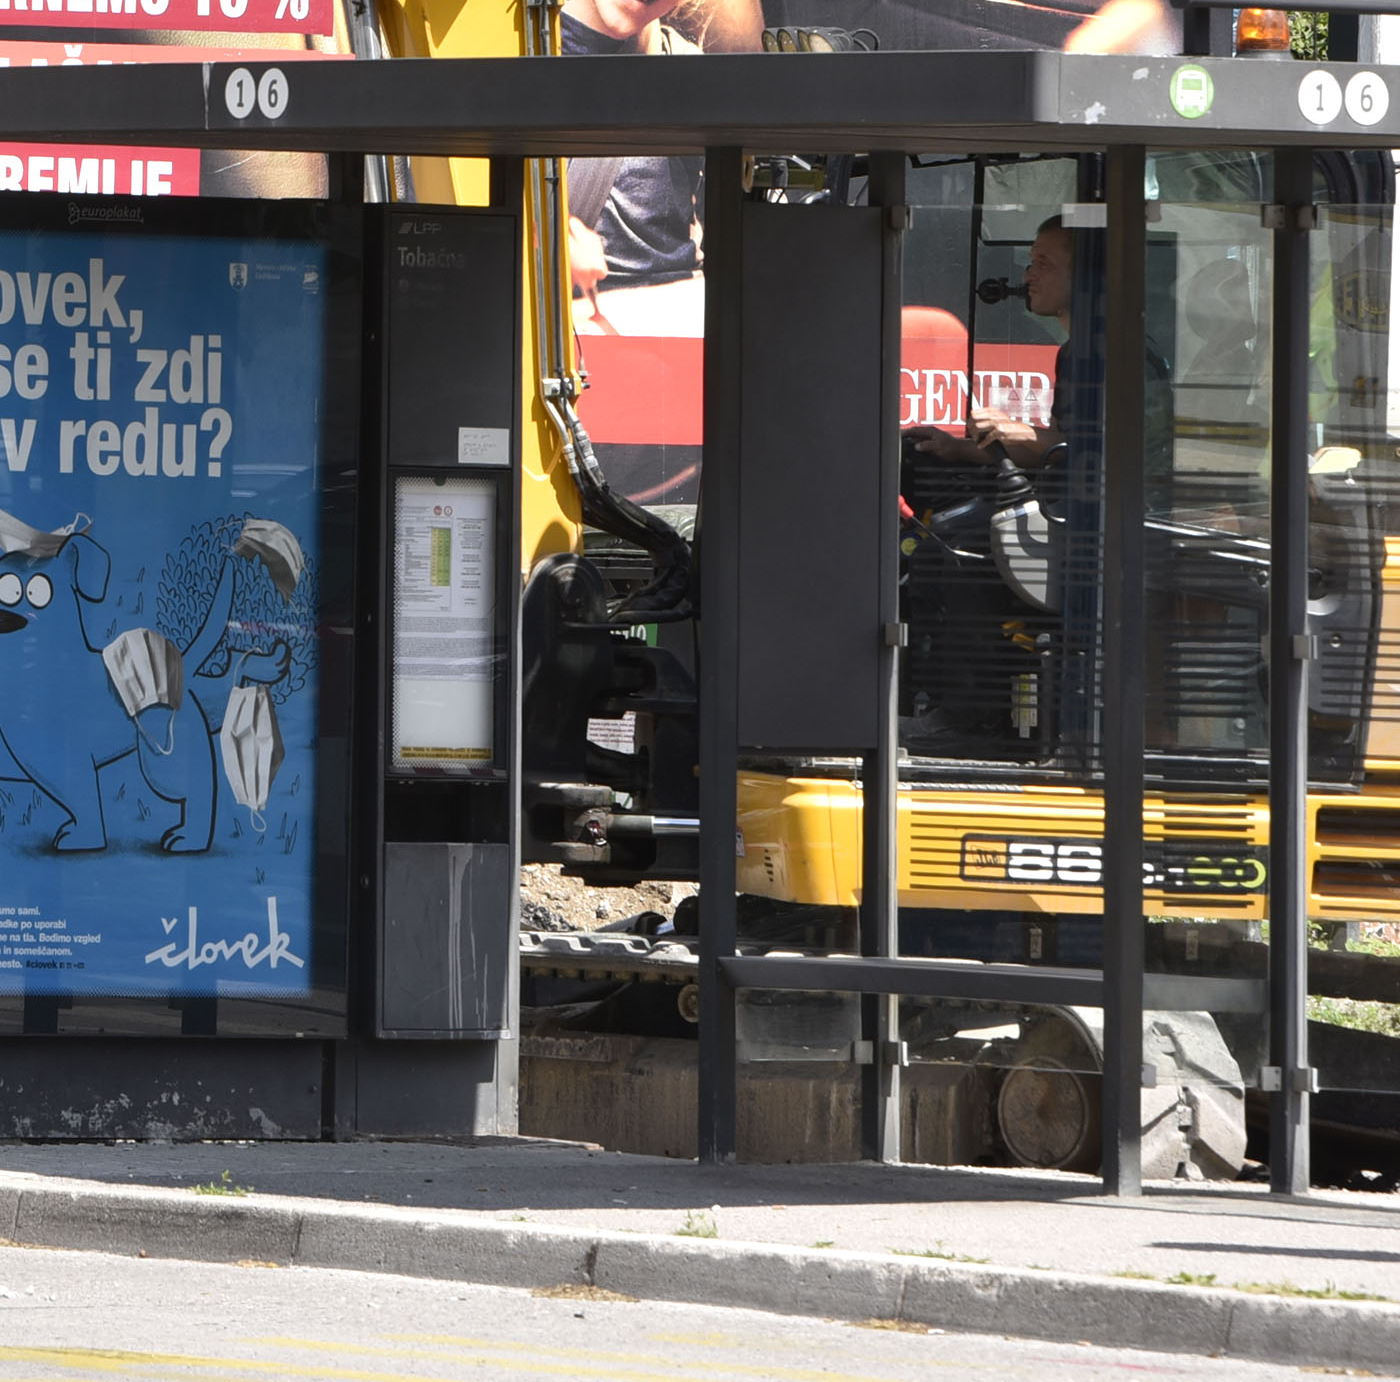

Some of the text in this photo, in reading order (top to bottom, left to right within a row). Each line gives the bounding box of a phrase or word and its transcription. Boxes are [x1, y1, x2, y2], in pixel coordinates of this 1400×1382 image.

[235, 78, 279, 109] 1 6
[1316, 83, 1373, 112] 1 6
[81, 205, 142, 220] europlakat
[69, 331, 112, 401] ti
[134, 334, 222, 404] zdi
[0, 418, 37, 472] v
[59, 406, 233, 478] redu?
[18, 905, 41, 916] sami.
[20, 921, 33, 930] po
[34, 919, 67, 931] uporabi
[145, 896, 305, 971] človek
[9, 934, 21, 942] na
[23, 932, 37, 943] tla.
[39, 933, 72, 944] Bodimo
[73, 933, 101, 945] vzgled
[3, 945, 12, 955] in
